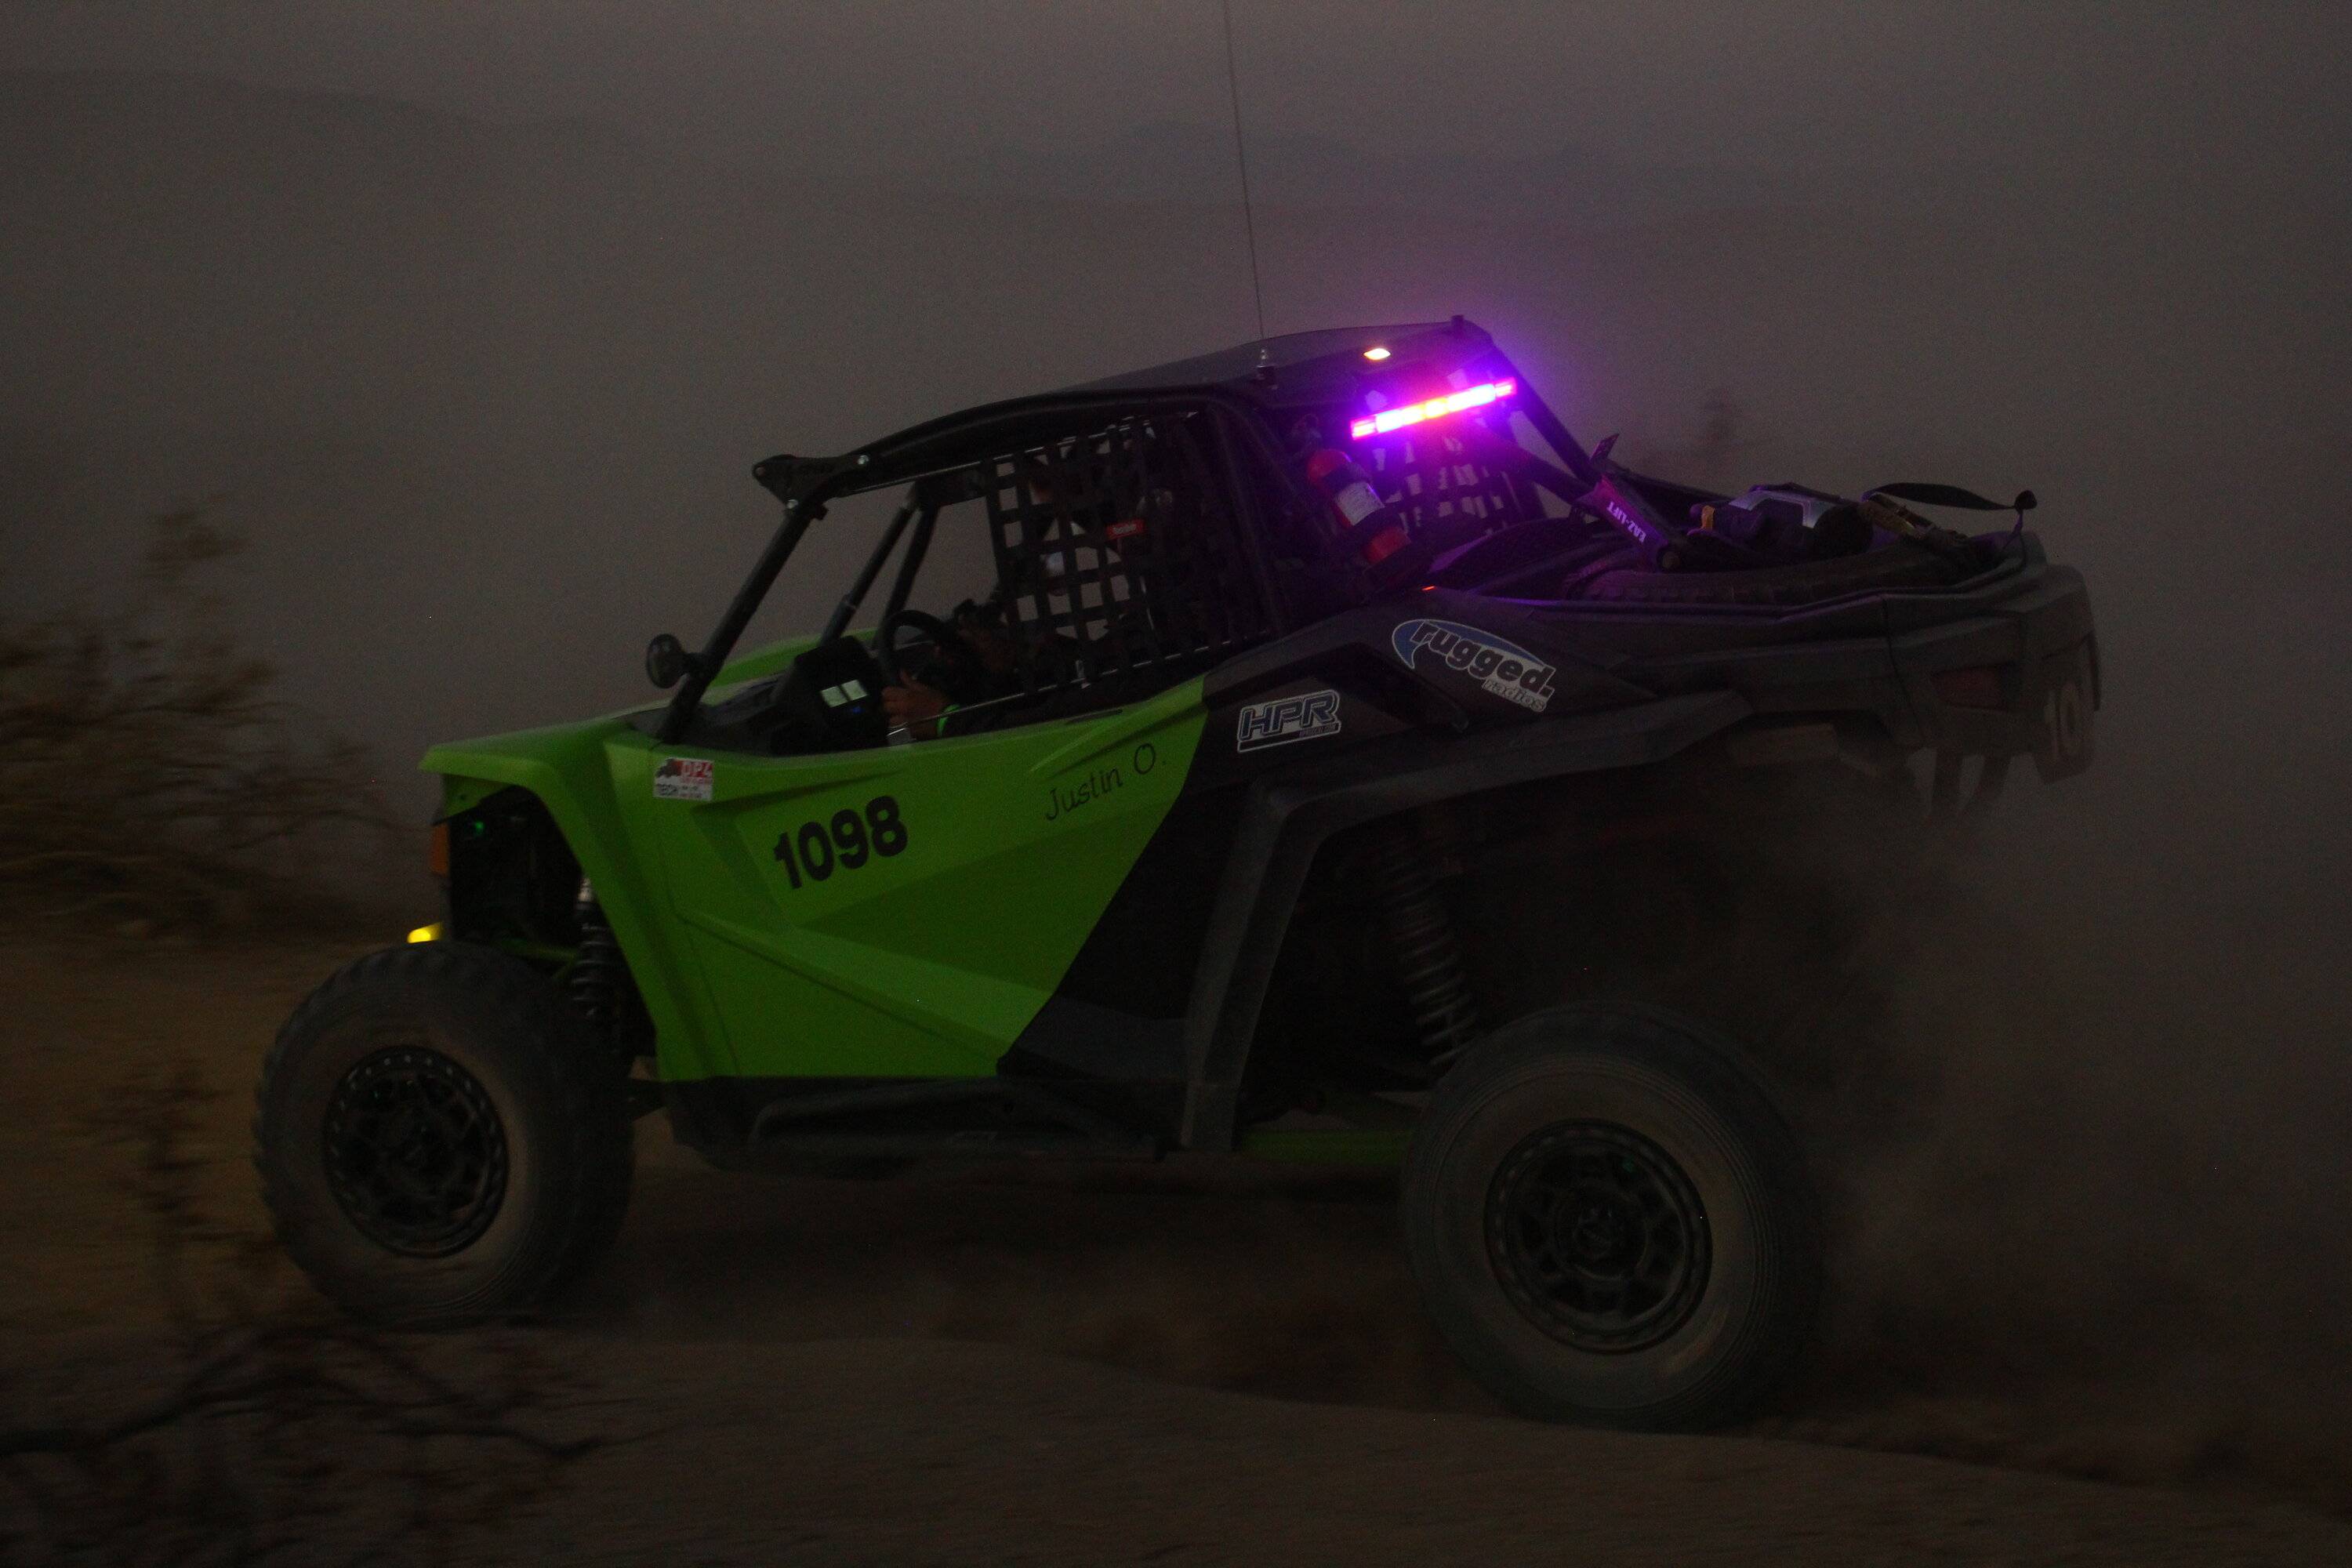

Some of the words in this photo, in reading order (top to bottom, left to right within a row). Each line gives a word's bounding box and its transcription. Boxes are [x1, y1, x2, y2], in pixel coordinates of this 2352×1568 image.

[1240, 691, 1338, 741] HPR
[1045, 768, 1123, 821] Justin
[773, 795, 909, 890] 1098
